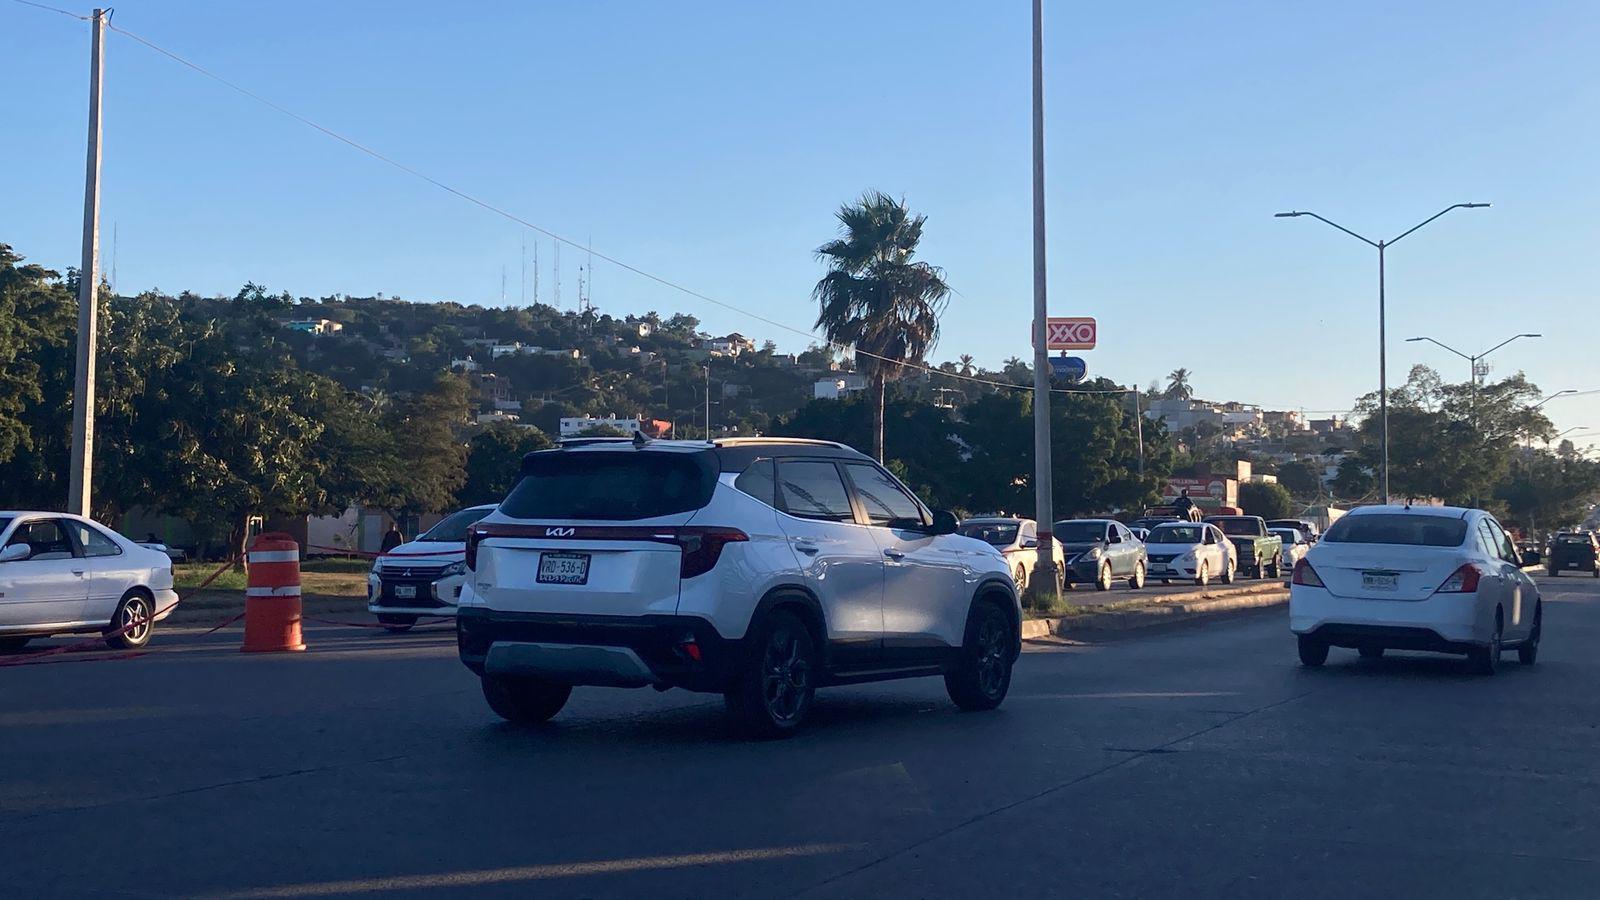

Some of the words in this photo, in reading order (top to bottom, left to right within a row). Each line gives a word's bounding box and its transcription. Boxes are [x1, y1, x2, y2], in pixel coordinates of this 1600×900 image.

[1047, 324, 1094, 342] XXO
[545, 527, 575, 537] KIA
[541, 560, 586, 574] VRD-536-D
